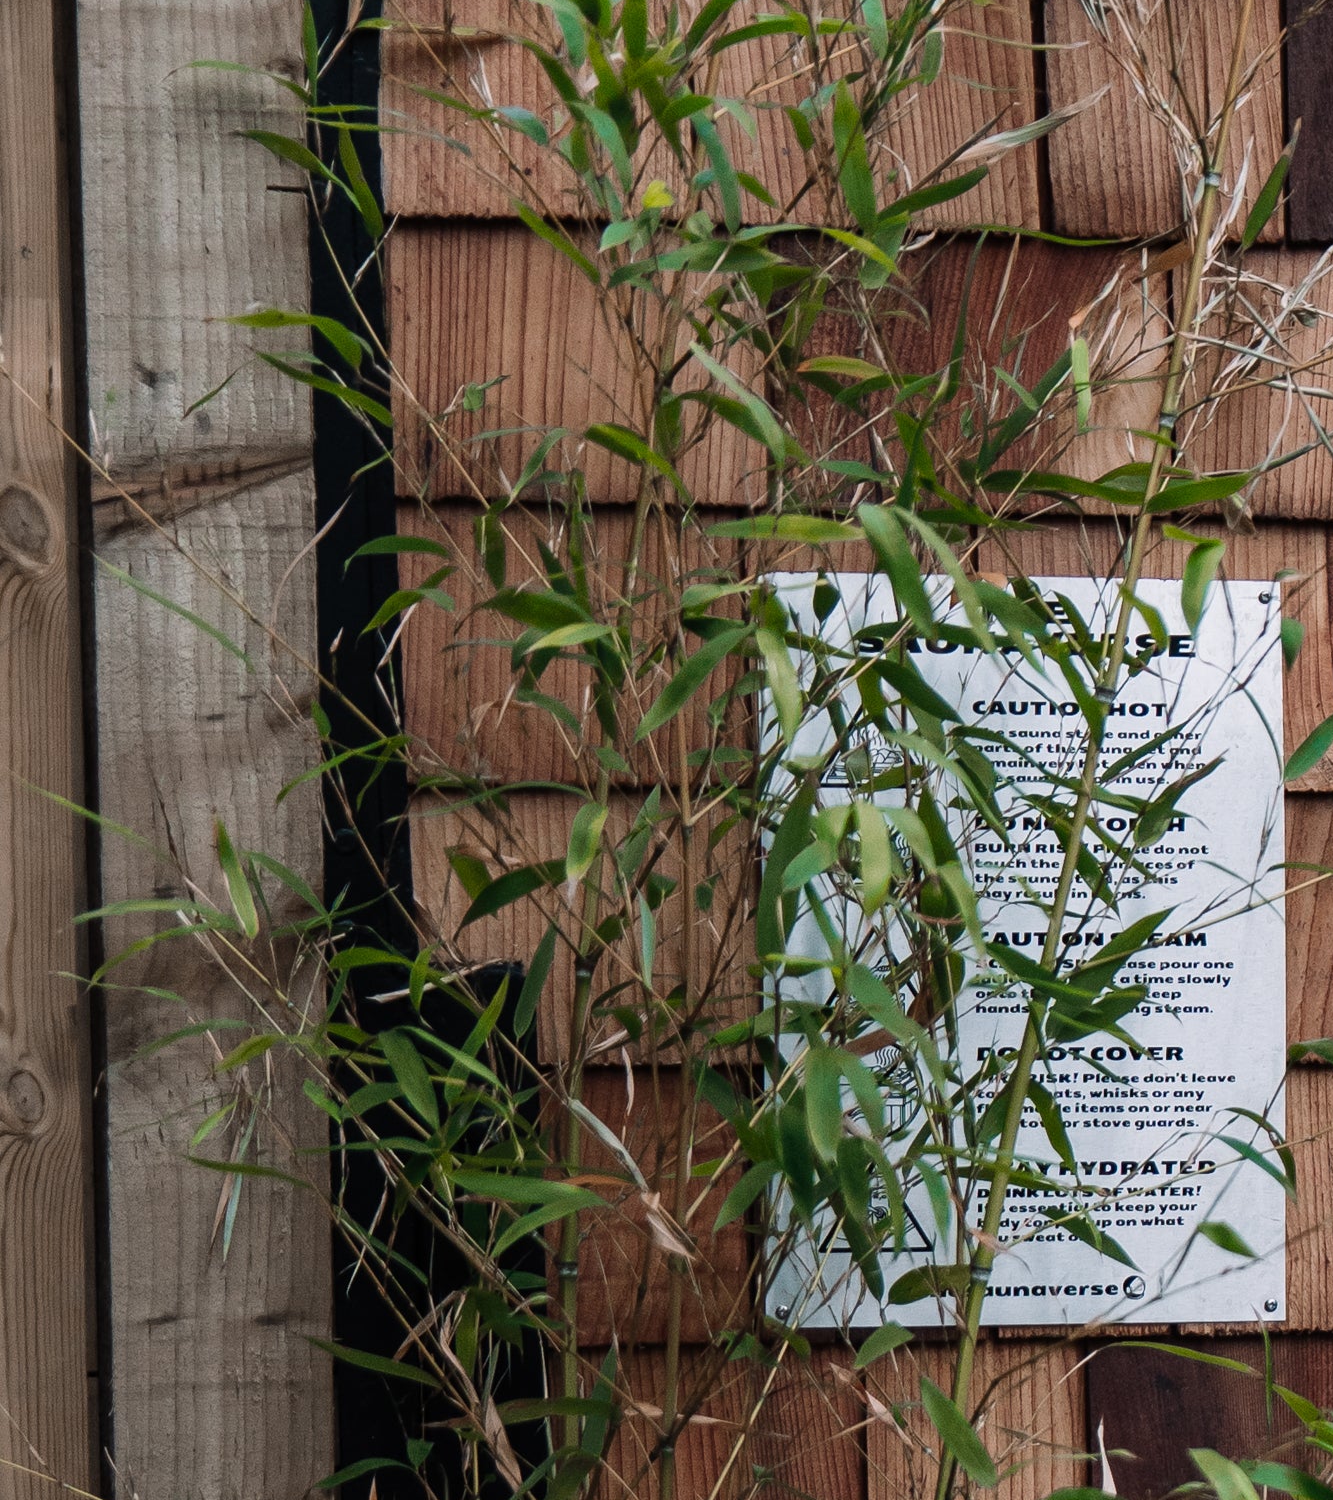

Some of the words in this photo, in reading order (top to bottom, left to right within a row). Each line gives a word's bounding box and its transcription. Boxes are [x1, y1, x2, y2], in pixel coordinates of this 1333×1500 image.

[972, 700, 1080, 716] CAUTIO
[1108, 703, 1167, 717] HOT
[1008, 730, 1060, 738] sauna
[1066, 729, 1114, 739] ste
[1117, 730, 1150, 739] and
[1025, 743, 1043, 753] of
[1080, 746, 1133, 754] suna
[1169, 746, 1202, 755] and
[992, 757, 1035, 768] main
[1079, 760, 1109, 769] ht
[1116, 775, 1132, 784] in
[1136, 777, 1170, 785] use.
[975, 843, 1031, 854] BURN
[1153, 845, 1175, 855] do
[1178, 845, 1209, 855] not
[975, 859, 1027, 869] touch
[1031, 859, 1060, 869] the
[1176, 860, 1196, 870] of
[974, 874, 1004, 884] the
[1121, 876, 1140, 885] as
[1071, 888, 1088, 899] in
[982, 931, 1104, 947] AUTON
[1159, 961, 1200, 971] pour
[1203, 961, 1234, 969] one
[1119, 976, 1130, 984] a
[1133, 973, 1174, 984] time
[1177, 974, 1231, 987] slowly
[1146, 991, 1182, 1000] eep
[975, 1004, 1030, 1014] hands
[1154, 1004, 1214, 1014] steam.
[1034, 1046, 1085, 1061] OT
[1090, 1046, 1184, 1061] COVER
[1143, 1073, 1189, 1083] don't
[1191, 1073, 1237, 1083] leave
[1090, 1088, 1149, 1099] whisks
[1152, 1090, 1170, 1098] or
[1173, 1090, 1205, 1101] any
[1075, 1102, 1125, 1113] items
[1128, 1105, 1149, 1113] on
[1153, 1105, 1171, 1113] or
[1174, 1105, 1213, 1113] near
[1083, 1119, 1131, 1128] stove
[1134, 1118, 1200, 1130] guards.
[1059, 1160, 1216, 1176] HYDRATED
[977, 1188, 1040, 1198] DINK
[1127, 1185, 1202, 1197] WATER!
[1115, 1202, 1155, 1214] keep
[1159, 1203, 1198, 1215] your
[977, 1218, 1020, 1231] bdy
[1116, 1219, 1137, 1227] on
[1141, 1216, 1185, 1227] what
